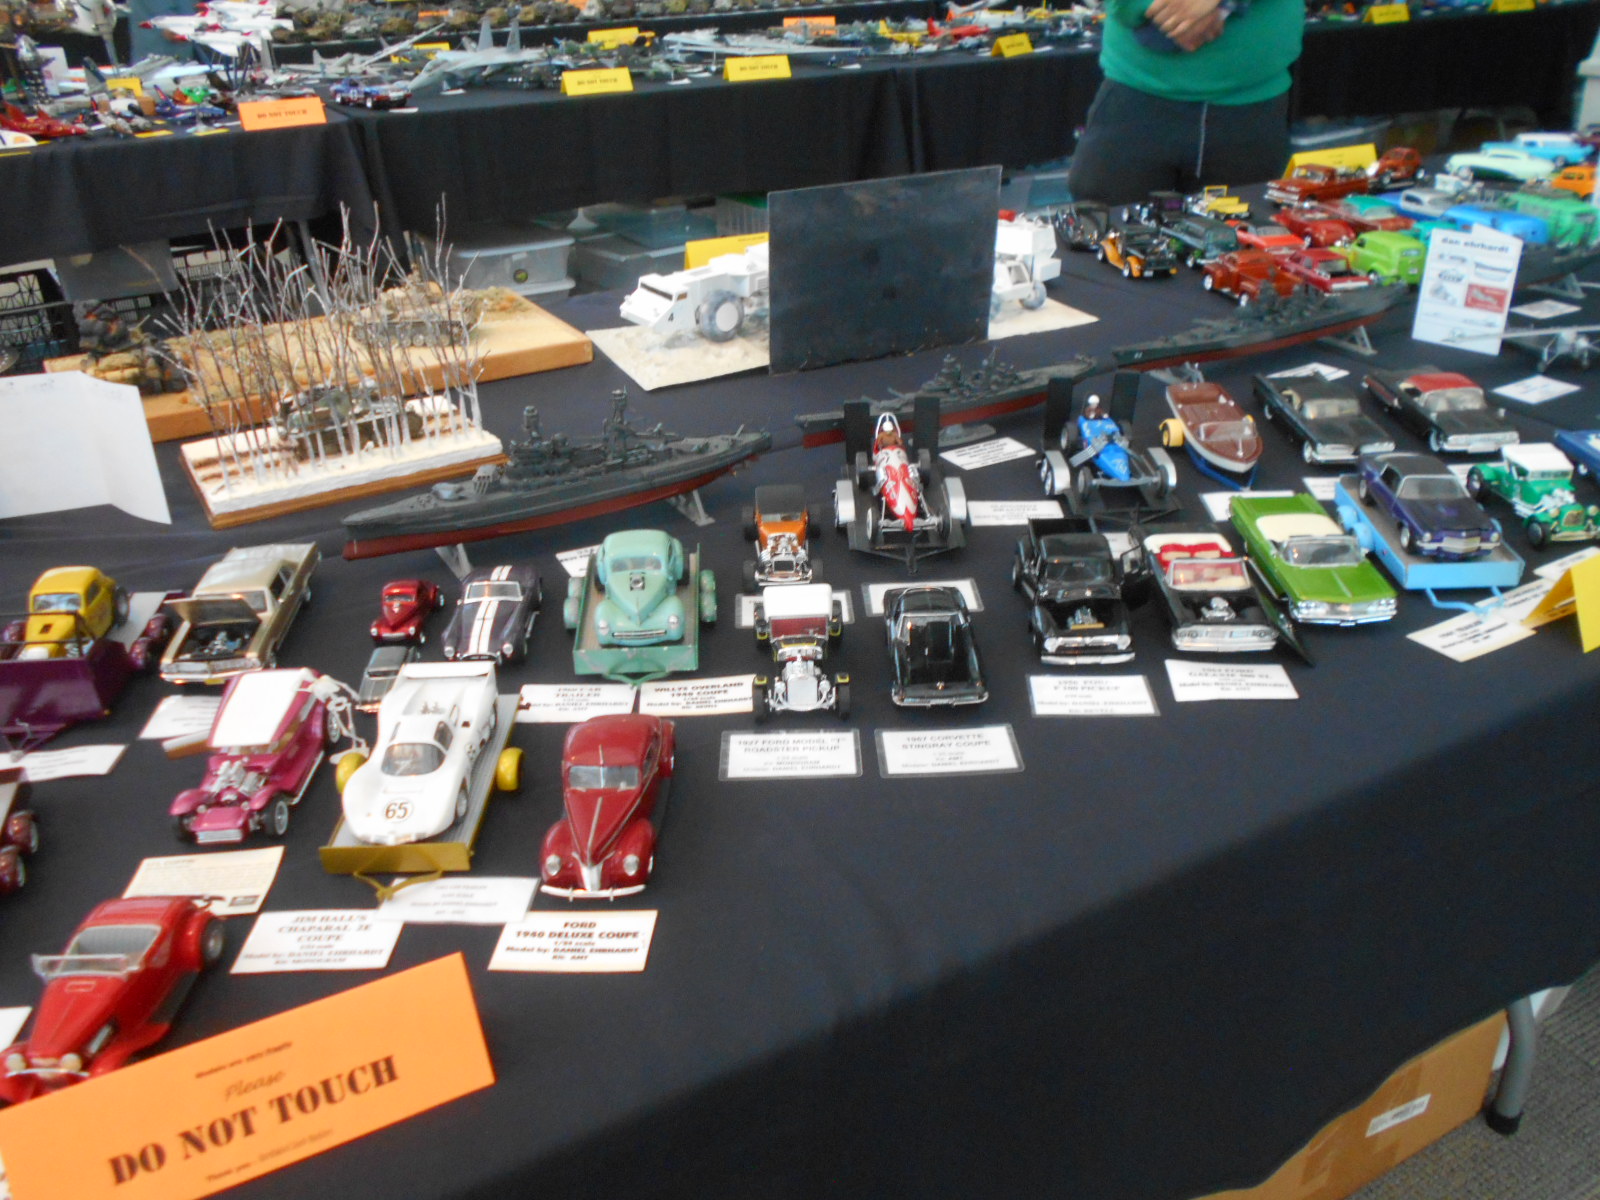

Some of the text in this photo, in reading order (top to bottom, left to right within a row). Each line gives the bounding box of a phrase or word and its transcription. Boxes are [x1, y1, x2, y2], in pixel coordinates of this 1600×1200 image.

[667, 312, 675, 322] 4
[691, 682, 744, 692] OVERLAND
[929, 733, 984, 741] CORVETTE
[901, 739, 991, 750] STINGRAY COUPE
[385, 802, 409, 820] 65
[292, 915, 317, 924] JIM
[563, 921, 597, 929] FORD
[296, 934, 344, 943] COUPE
[515, 931, 640, 939] 1940 DELUXE COUPE
[225, 1070, 287, 1102] Please
[107, 1142, 167, 1187] DO
[176, 1107, 263, 1161] NOT
[269, 1054, 400, 1126] TOUCH
